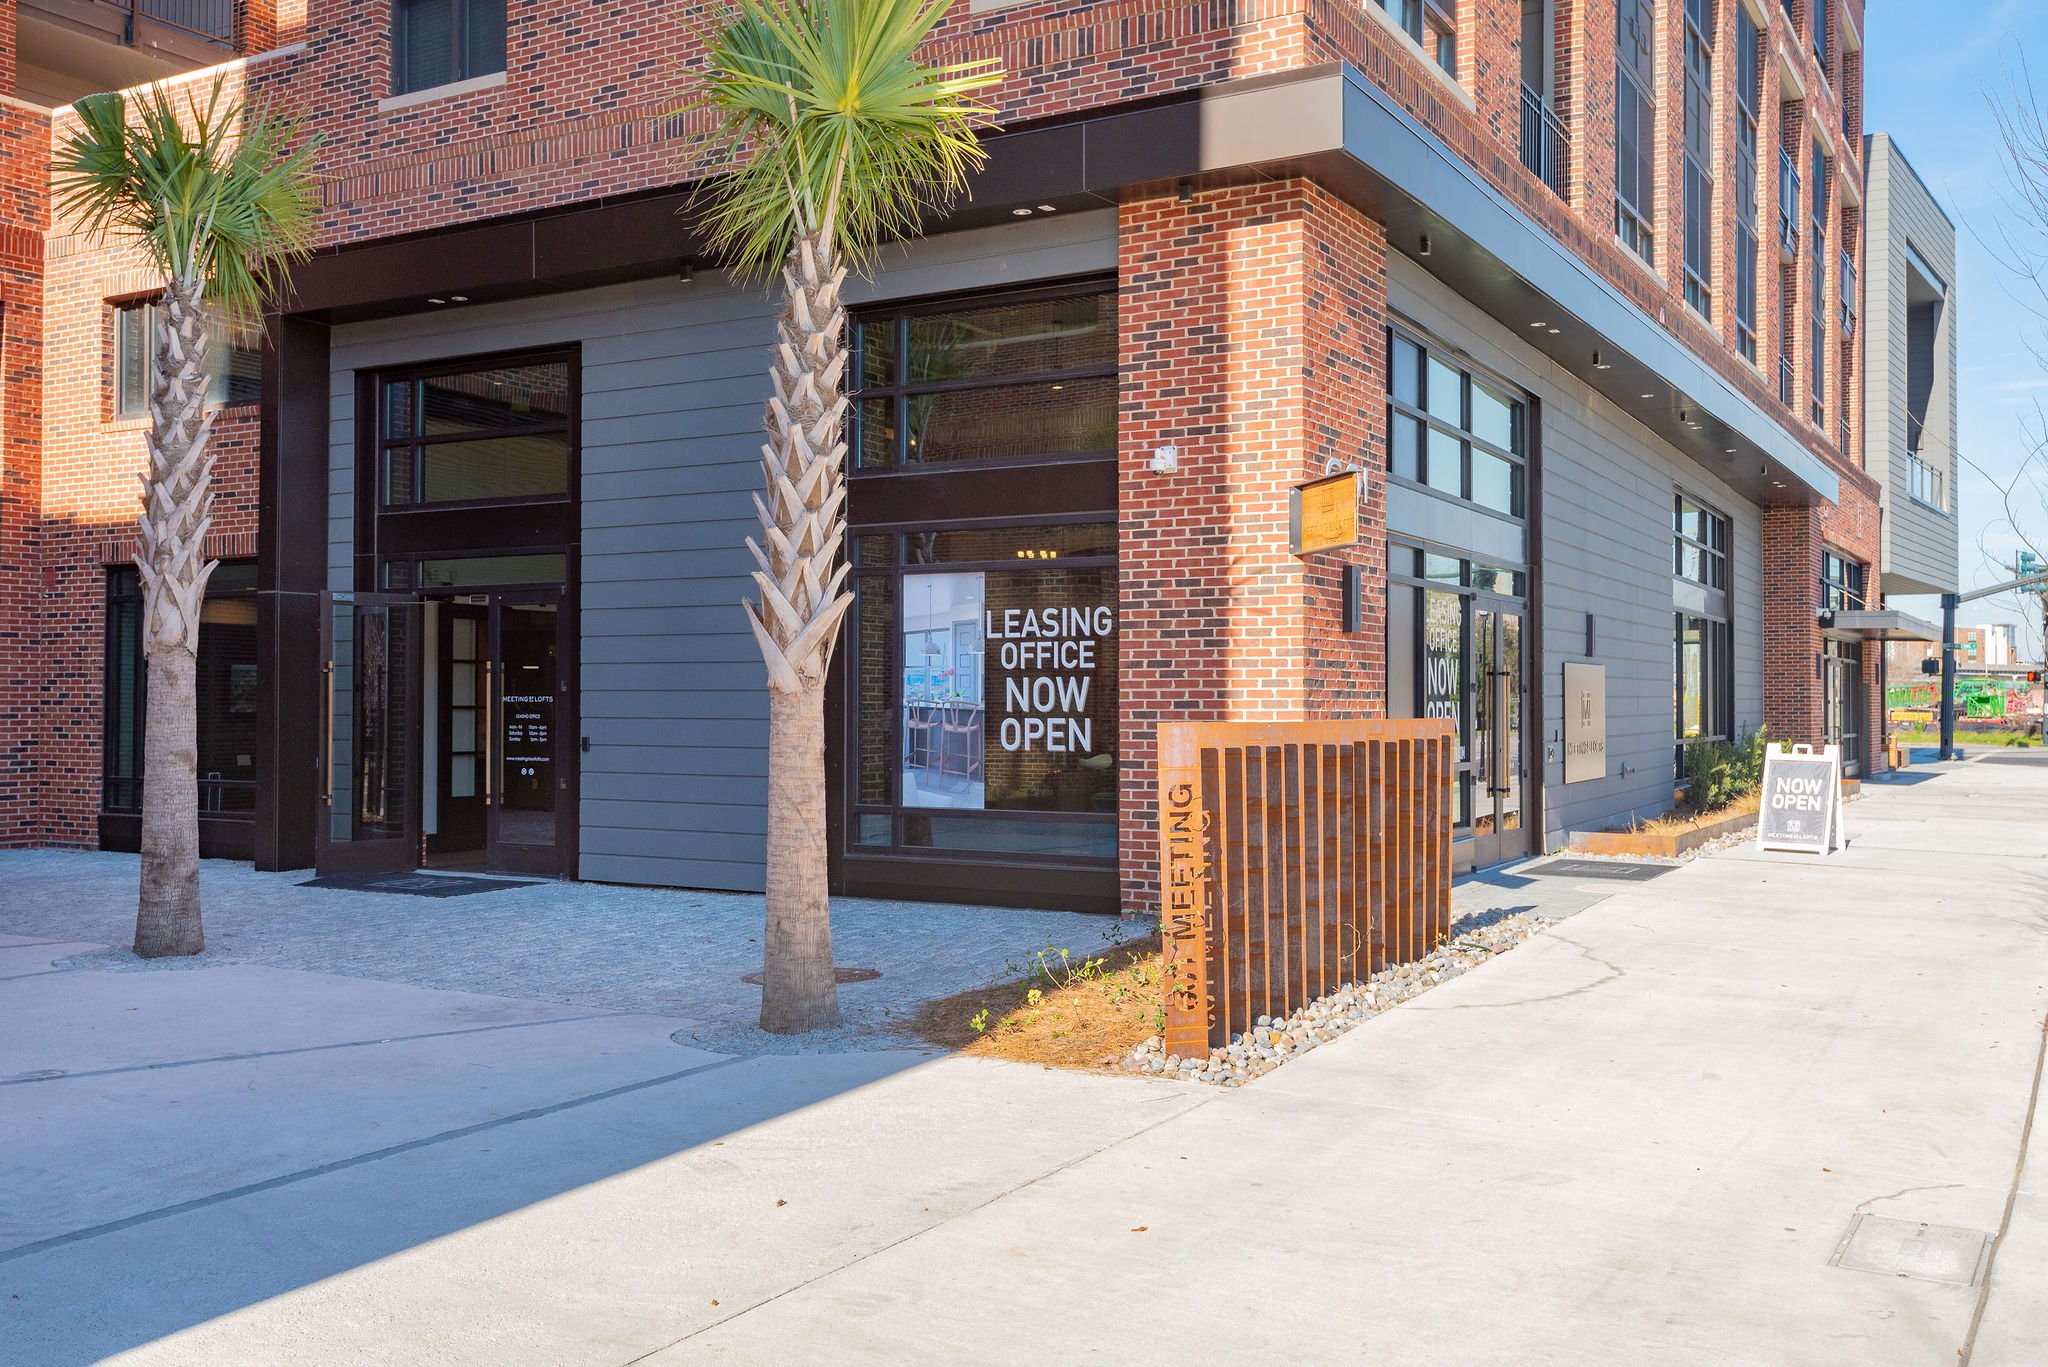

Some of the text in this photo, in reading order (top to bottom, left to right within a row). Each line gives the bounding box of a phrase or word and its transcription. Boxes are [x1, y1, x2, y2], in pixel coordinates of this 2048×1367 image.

[986, 606, 1113, 638] LEASING
[1001, 640, 1096, 670] OFFICE
[1429, 627, 1458, 653] OFFICE
[1428, 657, 1459, 696] NOW
[1006, 676, 1091, 713] NOW
[1000, 717, 1092, 752] OPEN
[1776, 777, 1823, 795] NOW
[1771, 794, 1822, 811] OPEN
[1168, 783, 1197, 941] MEETING
